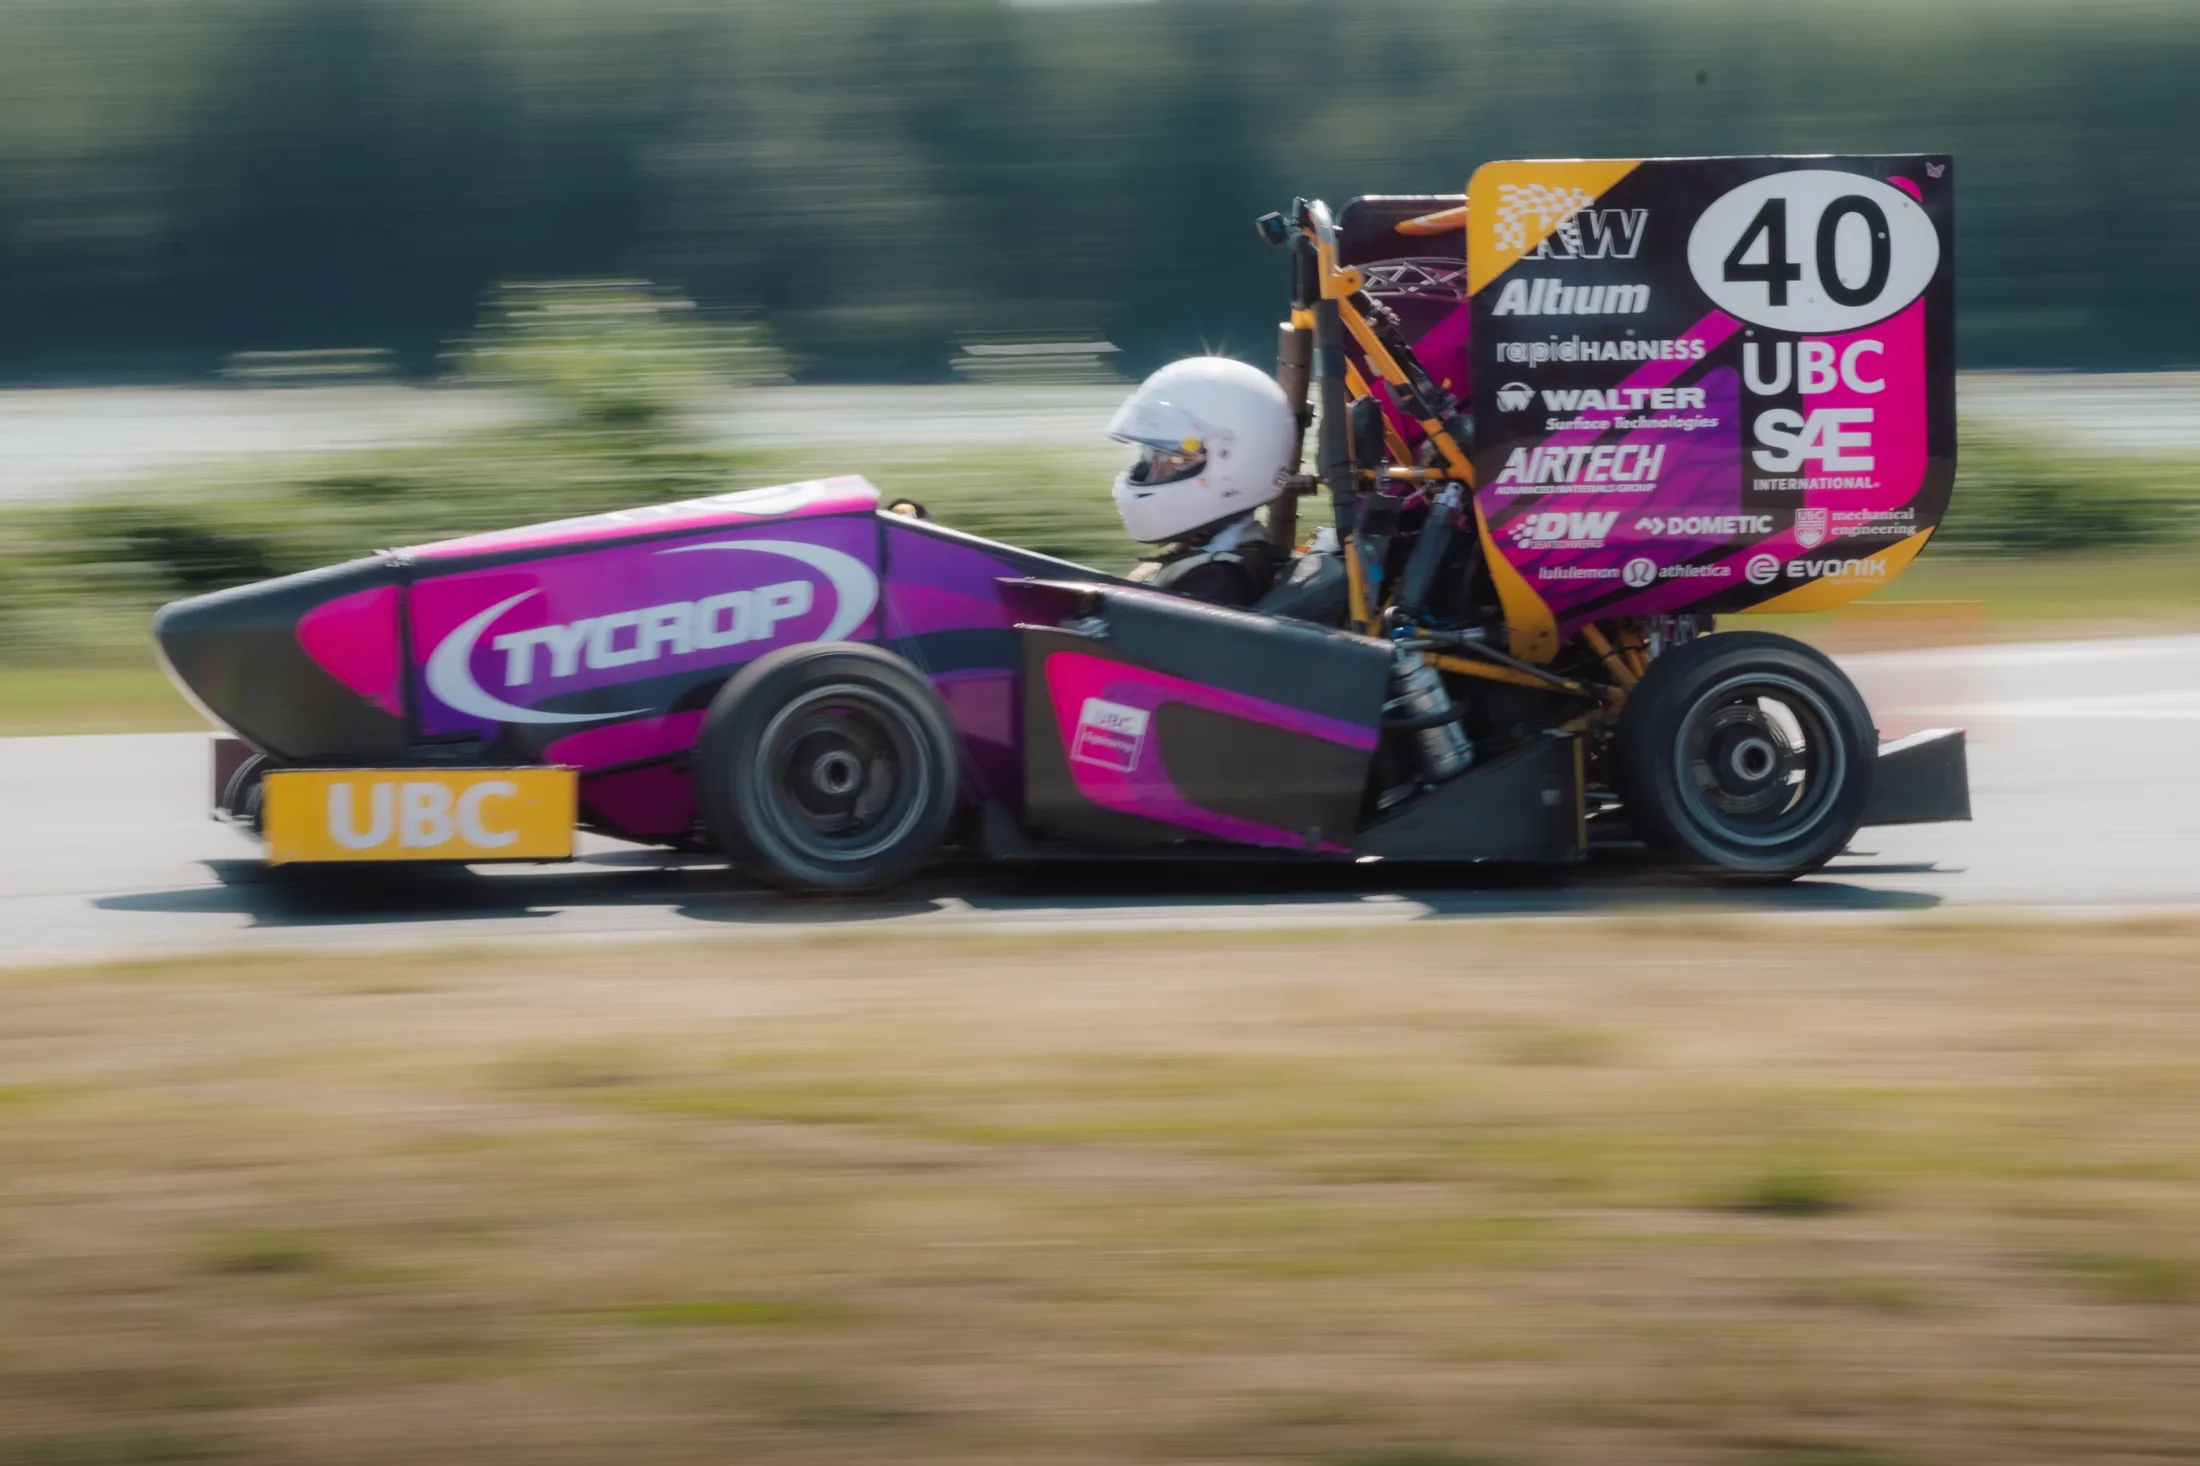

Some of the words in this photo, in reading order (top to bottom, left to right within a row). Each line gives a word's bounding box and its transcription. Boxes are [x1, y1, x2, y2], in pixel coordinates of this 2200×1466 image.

[1722, 194, 1891, 307] 40
[1491, 278, 1650, 316] Altium
[1496, 334, 1706, 368] rapidHARNESS
[1743, 339, 1886, 396] UBC
[1541, 387, 1707, 412] WALTER
[1545, 416, 1611, 431] Surface
[1613, 415, 1719, 432] Technologies
[1751, 407, 1875, 473] SAE
[1495, 444, 1667, 484] AIRTECH
[1532, 511, 1621, 541] DW
[1667, 515, 1774, 535] DOMETIC
[1831, 507, 1915, 521] mechanical
[1831, 522, 1918, 537] engineering
[1538, 566, 1621, 580] lululemon
[1658, 564, 1731, 579] athletica
[493, 579, 815, 687] TYCROP
[326, 780, 520, 849] UBC
